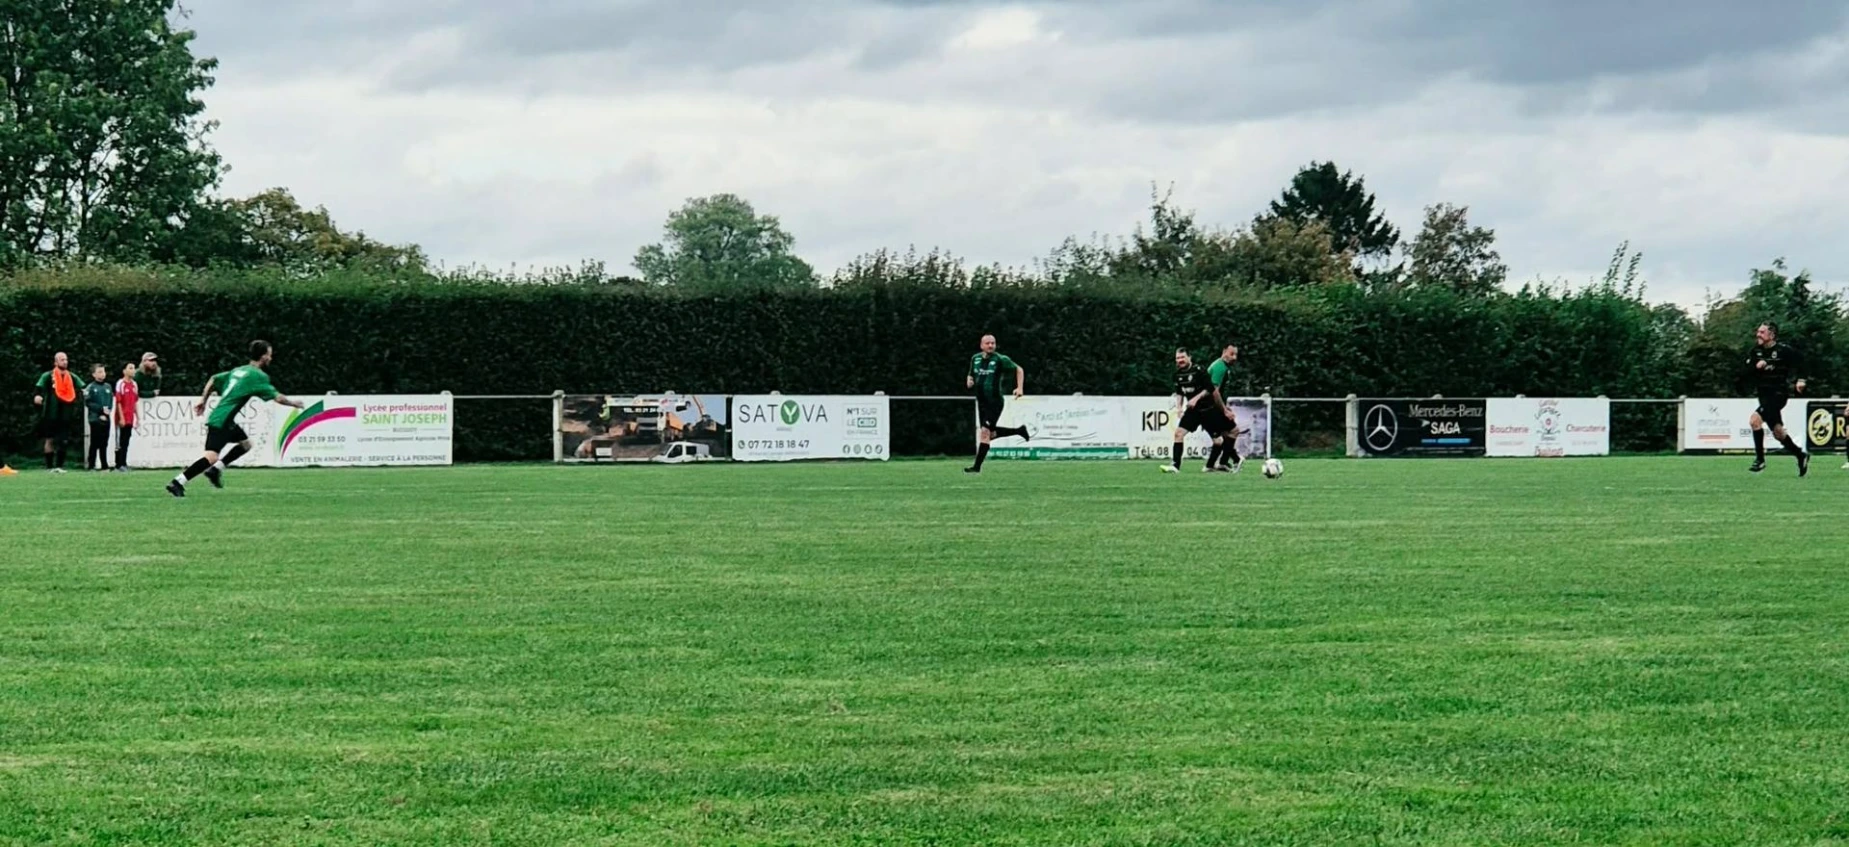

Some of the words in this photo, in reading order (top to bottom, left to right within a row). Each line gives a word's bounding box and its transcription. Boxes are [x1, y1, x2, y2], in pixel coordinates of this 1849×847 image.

[389, 402, 447, 412] professionnel
[861, 407, 877, 415] SUR
[1408, 404, 1484, 418] Mercedes-Benz
[738, 403, 828, 423] SATYVA
[362, 413, 398, 425] SAINT
[401, 413, 447, 424] JOSEPH
[846, 419, 856, 427] LE
[1430, 421, 1461, 435] SAGA
[1489, 424, 1529, 434] Boucherie
[1565, 423, 1606, 432] Charcuterie
[747, 439, 759, 449] 07
[761, 439, 773, 449] 72
[775, 439, 785, 449] 18
[786, 439, 796, 449] 18
[798, 439, 810, 449] 47
[1157, 446, 1169, 456] 08
[1187, 446, 1199, 456] 04
